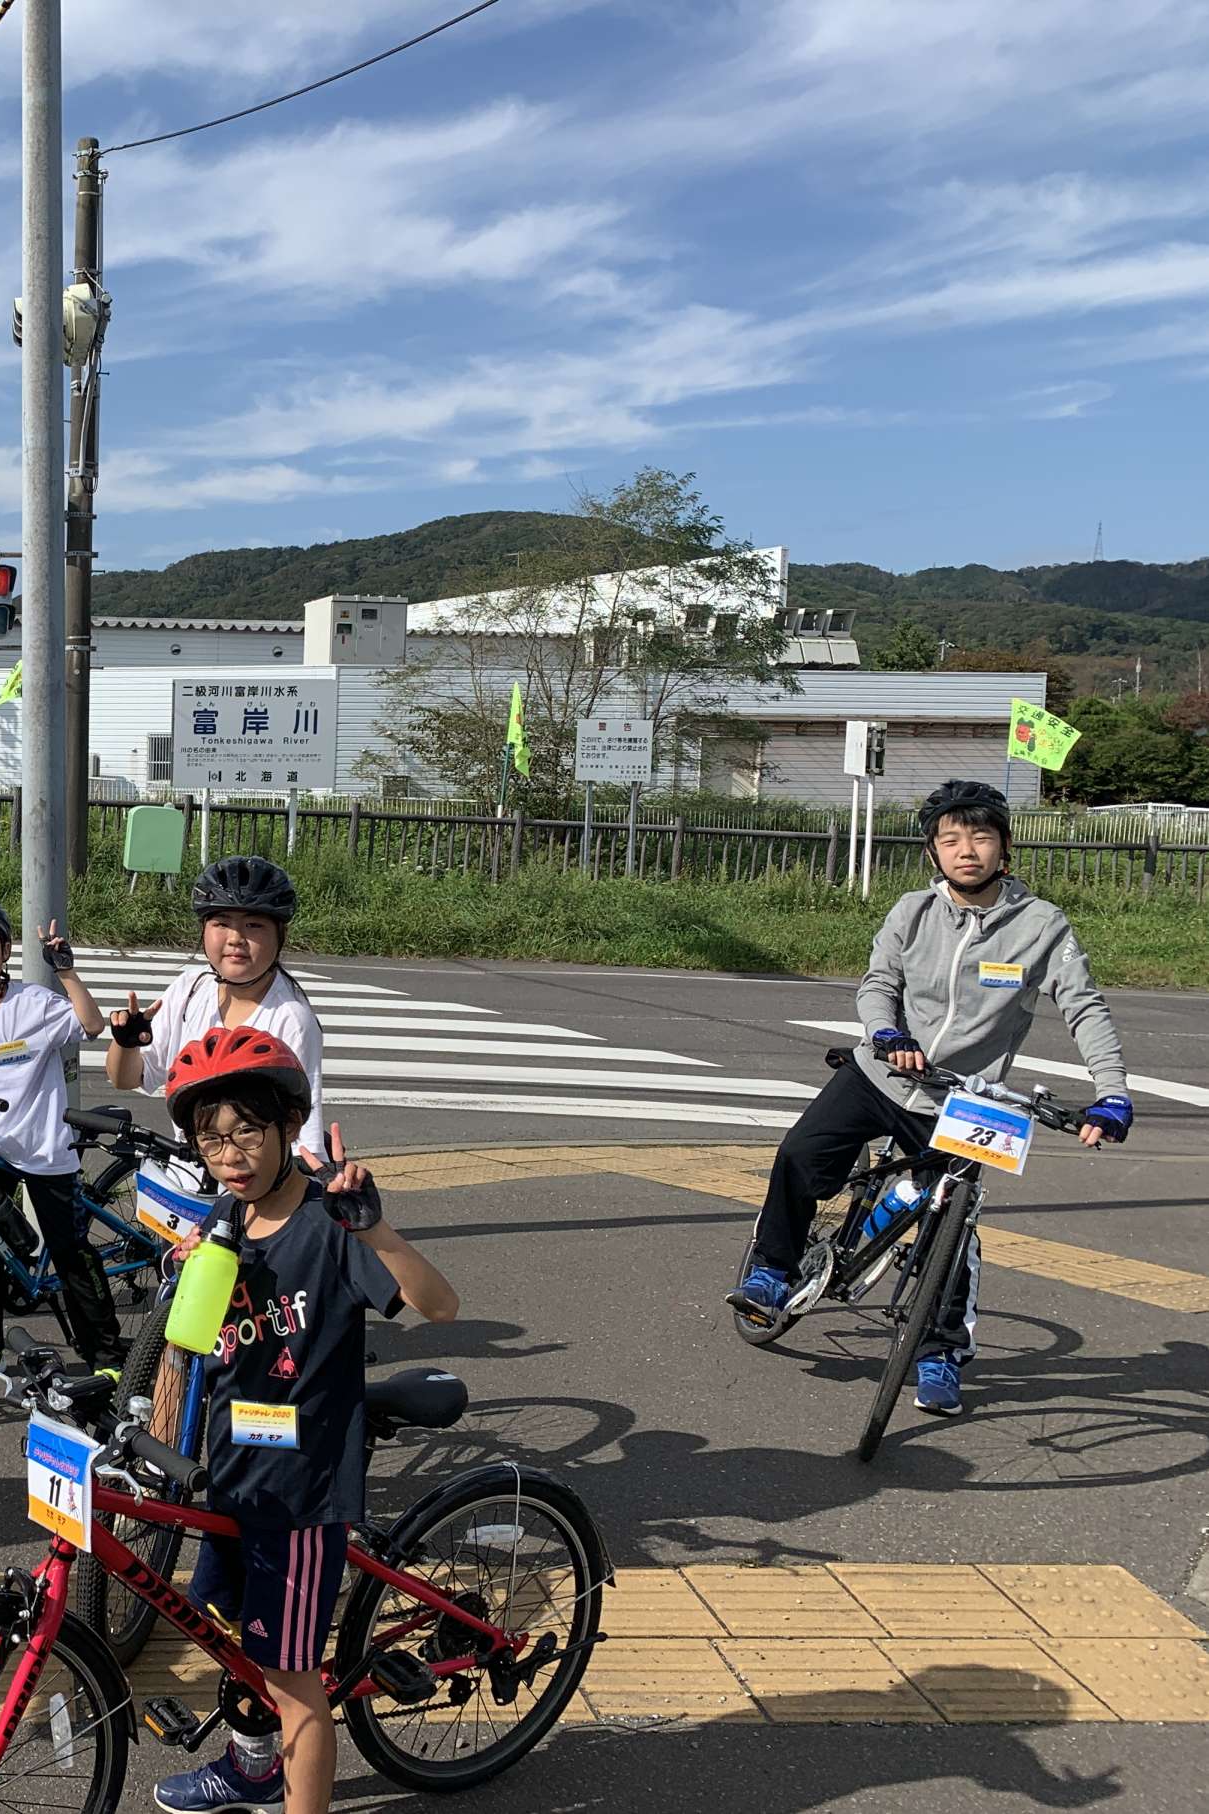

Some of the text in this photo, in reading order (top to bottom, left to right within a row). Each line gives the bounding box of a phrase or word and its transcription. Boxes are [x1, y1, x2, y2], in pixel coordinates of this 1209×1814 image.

[182, 685, 299, 698] 二級河川富岸川水系
[192, 707, 318, 736] 富岸川
[1016, 705, 1075, 738] 交通安全
[201, 737, 310, 745] Tonkeshigawa River
[235, 770, 299, 783] 北海道
[965, 1126, 997, 1147] 23
[166, 1213, 181, 1231] 3
[49, 1475, 63, 1508] 11
